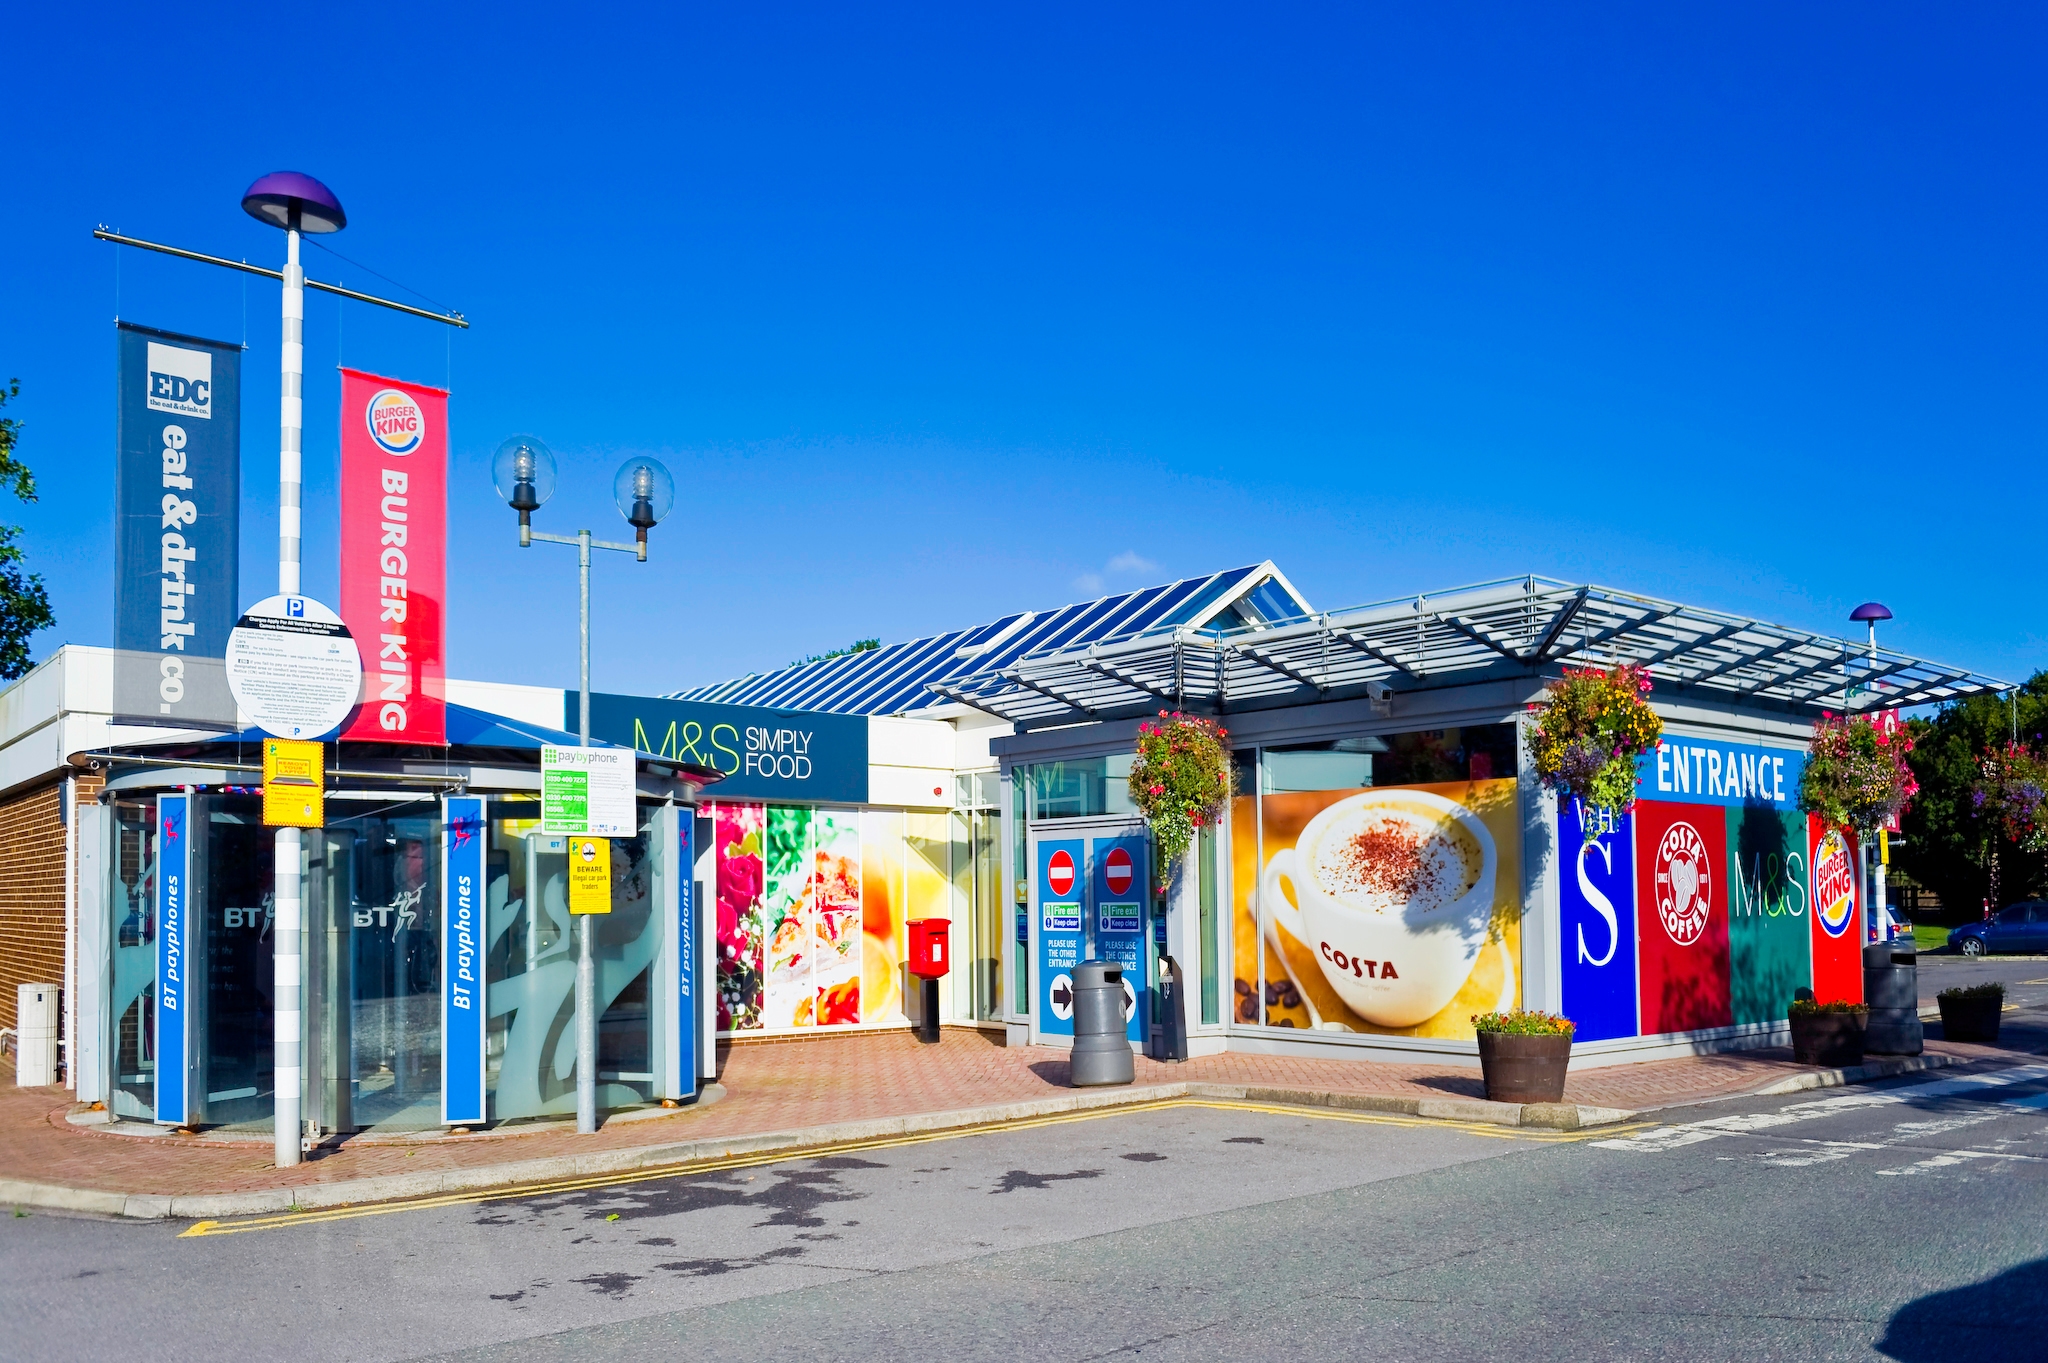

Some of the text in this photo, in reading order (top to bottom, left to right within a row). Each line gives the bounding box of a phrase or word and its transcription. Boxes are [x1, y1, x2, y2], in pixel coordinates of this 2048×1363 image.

[150, 371, 209, 406] EDC
[149, 398, 209, 415] the eat & drink co.
[374, 406, 416, 421] BURGER
[376, 416, 418, 436] KING
[162, 424, 193, 490] eat
[379, 469, 409, 732] BURGER KING
[635, 718, 740, 777] M&S
[745, 726, 813, 755] SIMPLY
[558, 750, 618, 764] paybyphone
[745, 753, 812, 780] FOOD
[1657, 743, 1786, 802] ENTRANCE
[1662, 826, 1701, 864] COSTA
[596, 874, 607, 882] park
[1657, 872, 1669, 884] SINCE
[1817, 850, 1849, 888] BURGER
[1734, 851, 1806, 917] M&S
[1820, 868, 1850, 916] KING
[223, 906, 262, 928] BT
[353, 906, 395, 928] BT
[1054, 904, 1078, 916] Fire exit
[1111, 905, 1138, 916] Fire exit
[1661, 897, 1707, 940] COFFEE
[1054, 918, 1078, 928] Keep clear
[1111, 919, 1138, 928] Keep clear
[163, 874, 180, 1011] BT payphones
[453, 874, 476, 1010] BT payphones
[681, 878, 694, 997] BT payphones
[1048, 940, 1076, 948] PLEASE USE
[1105, 941, 1136, 950] PLEASE USE
[1048, 949, 1076, 958] THE OTHER
[1048, 958, 1076, 968] ENTRANCE
[1105, 950, 1136, 960] THE OTHER
[1320, 941, 1399, 980] COSTA
